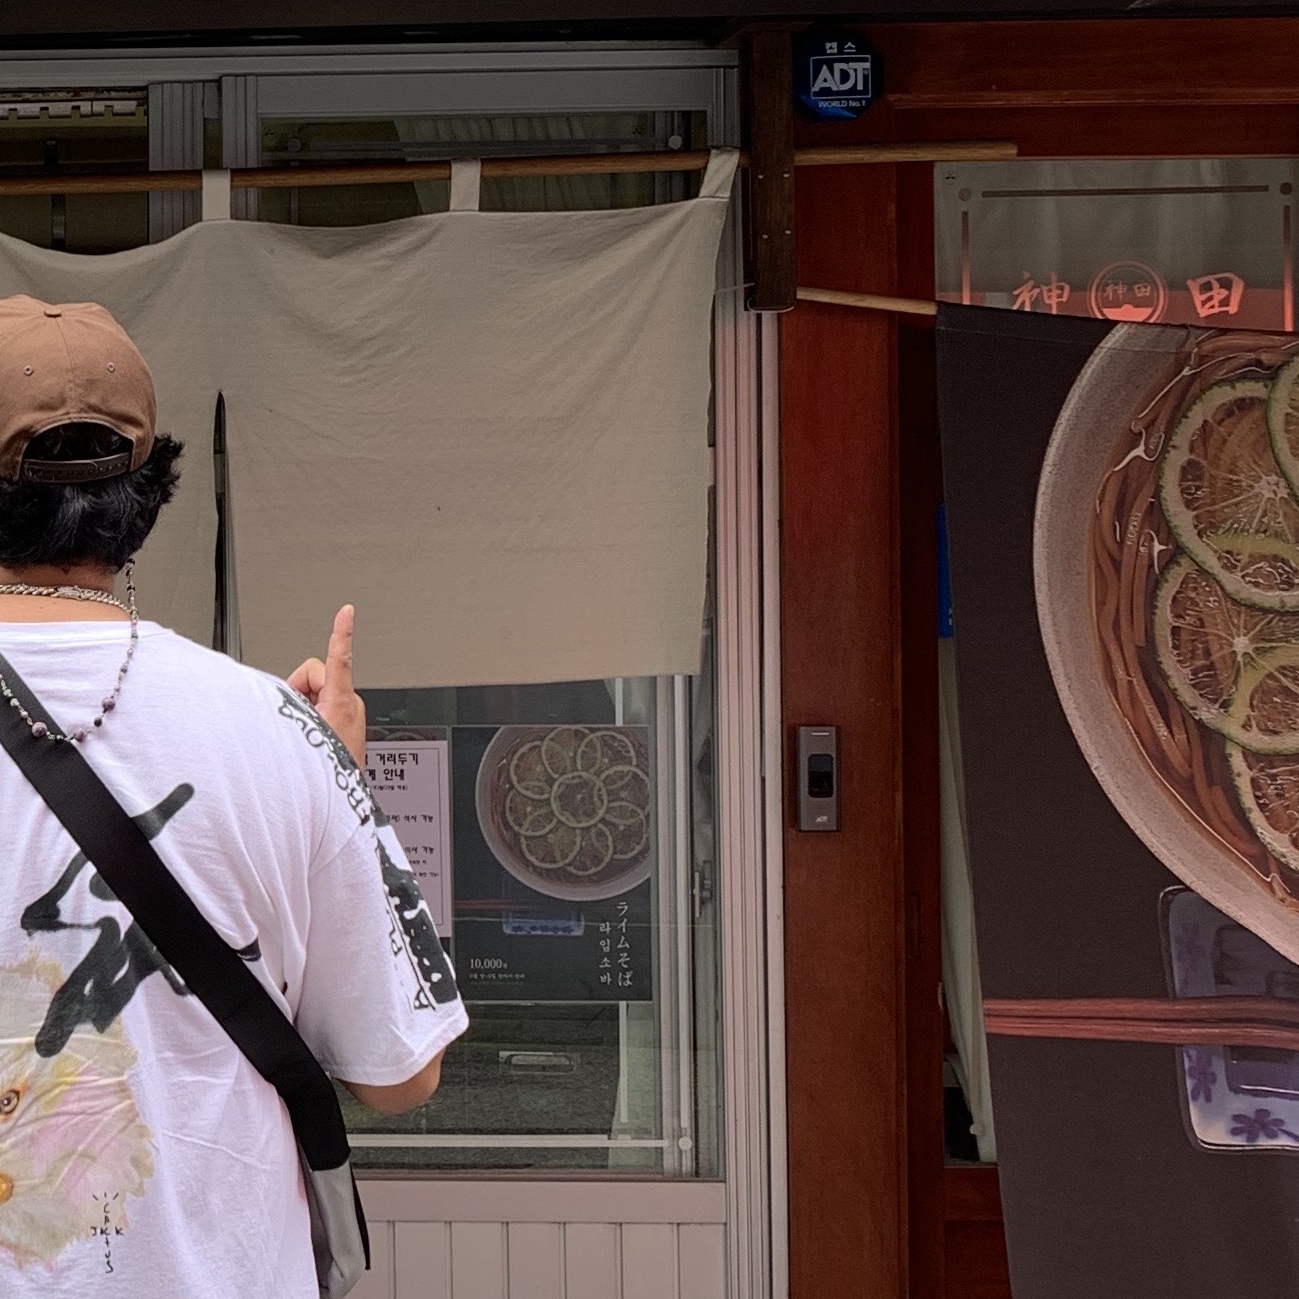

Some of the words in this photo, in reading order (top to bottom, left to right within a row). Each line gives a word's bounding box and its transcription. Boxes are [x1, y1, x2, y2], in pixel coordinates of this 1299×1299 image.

[825, 41, 857, 54] 캡스
[811, 61, 871, 93] ADT
[818, 100, 848, 108] WORLD
[1011, 270, 1071, 315] 神
[376, 752, 419, 766] 거리두기
[383, 769, 406, 781] 안내
[598, 921, 612, 986] 라임소바
[617, 901, 634, 987] ライムそば
